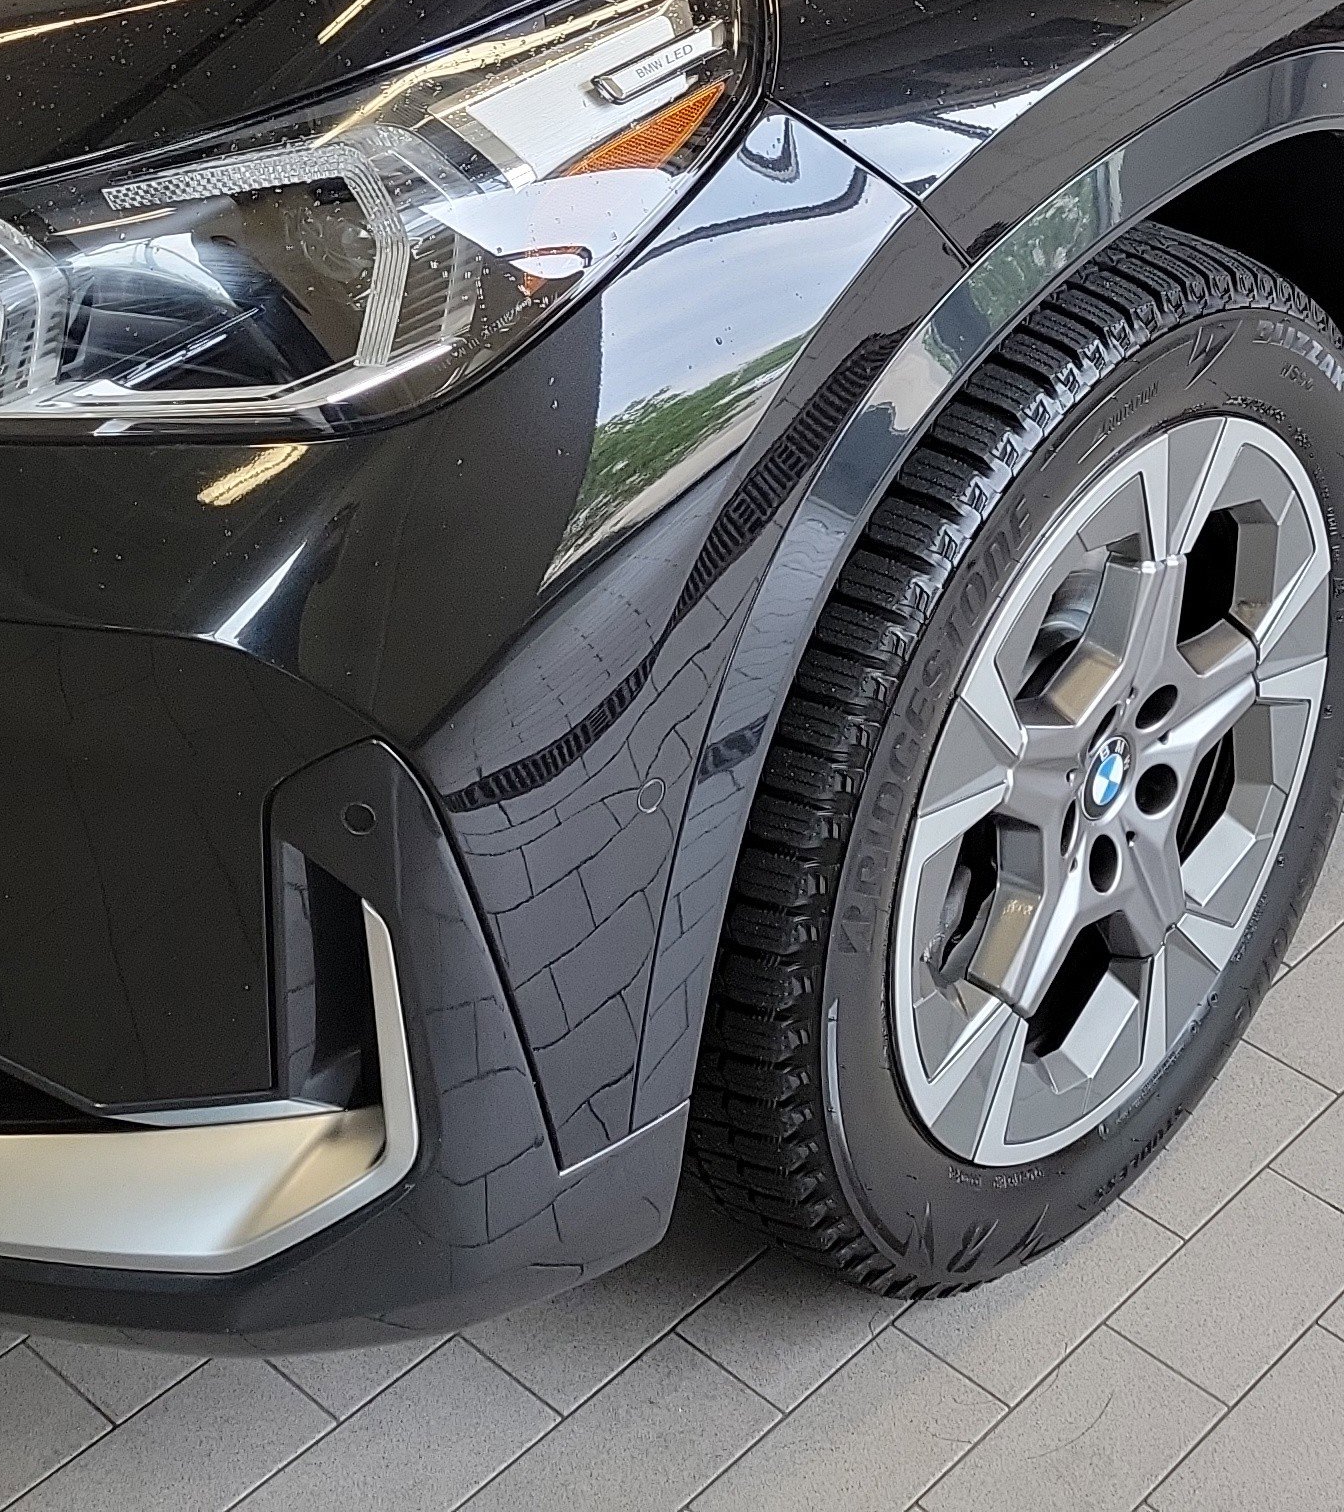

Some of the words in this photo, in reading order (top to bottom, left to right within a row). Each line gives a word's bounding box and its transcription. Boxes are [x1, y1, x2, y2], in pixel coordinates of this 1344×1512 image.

[635, 58, 663, 79] BMW
[665, 44, 693, 65] LED
[840, 493, 1031, 955] BRIDGESTONE
[1099, 738, 1132, 772] BMW
